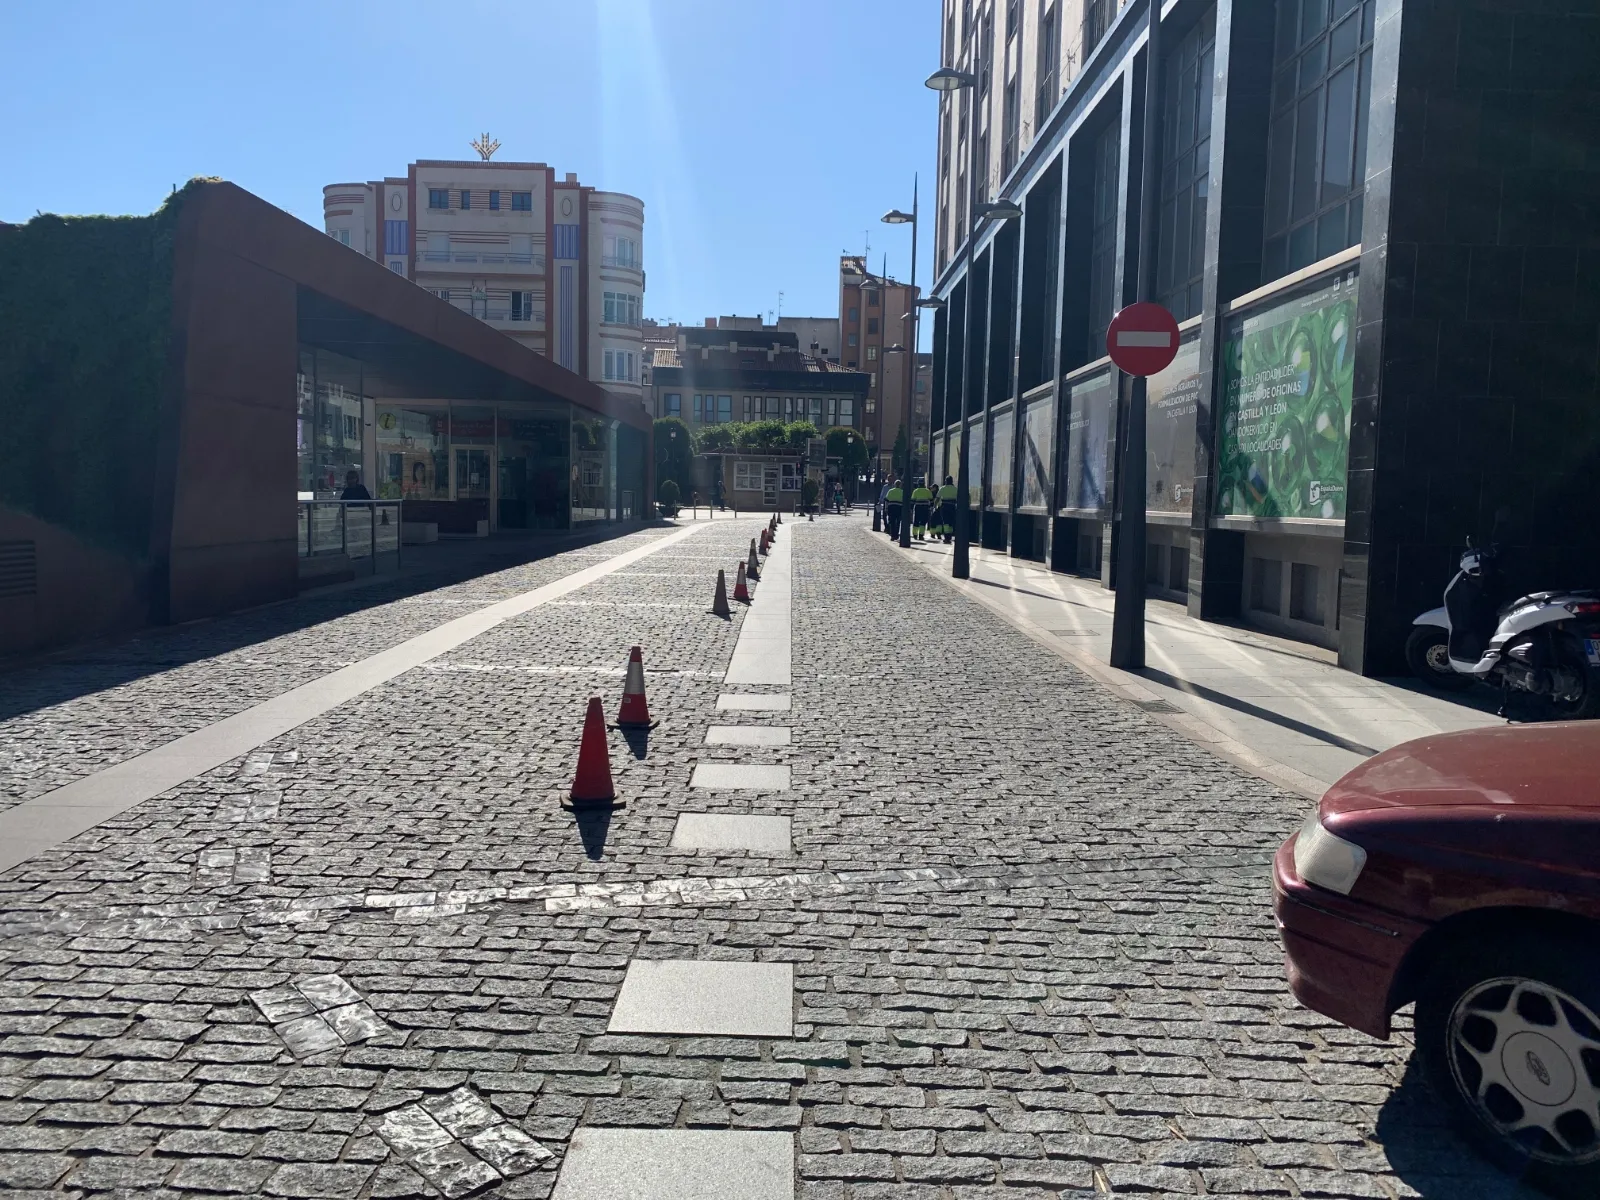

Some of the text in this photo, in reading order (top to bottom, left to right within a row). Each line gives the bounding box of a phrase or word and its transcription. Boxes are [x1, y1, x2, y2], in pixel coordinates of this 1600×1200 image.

[1271, 380, 1302, 398] OFICINAS
[1237, 406, 1264, 421] CASTILLA
[1264, 404, 1269, 417] Y
